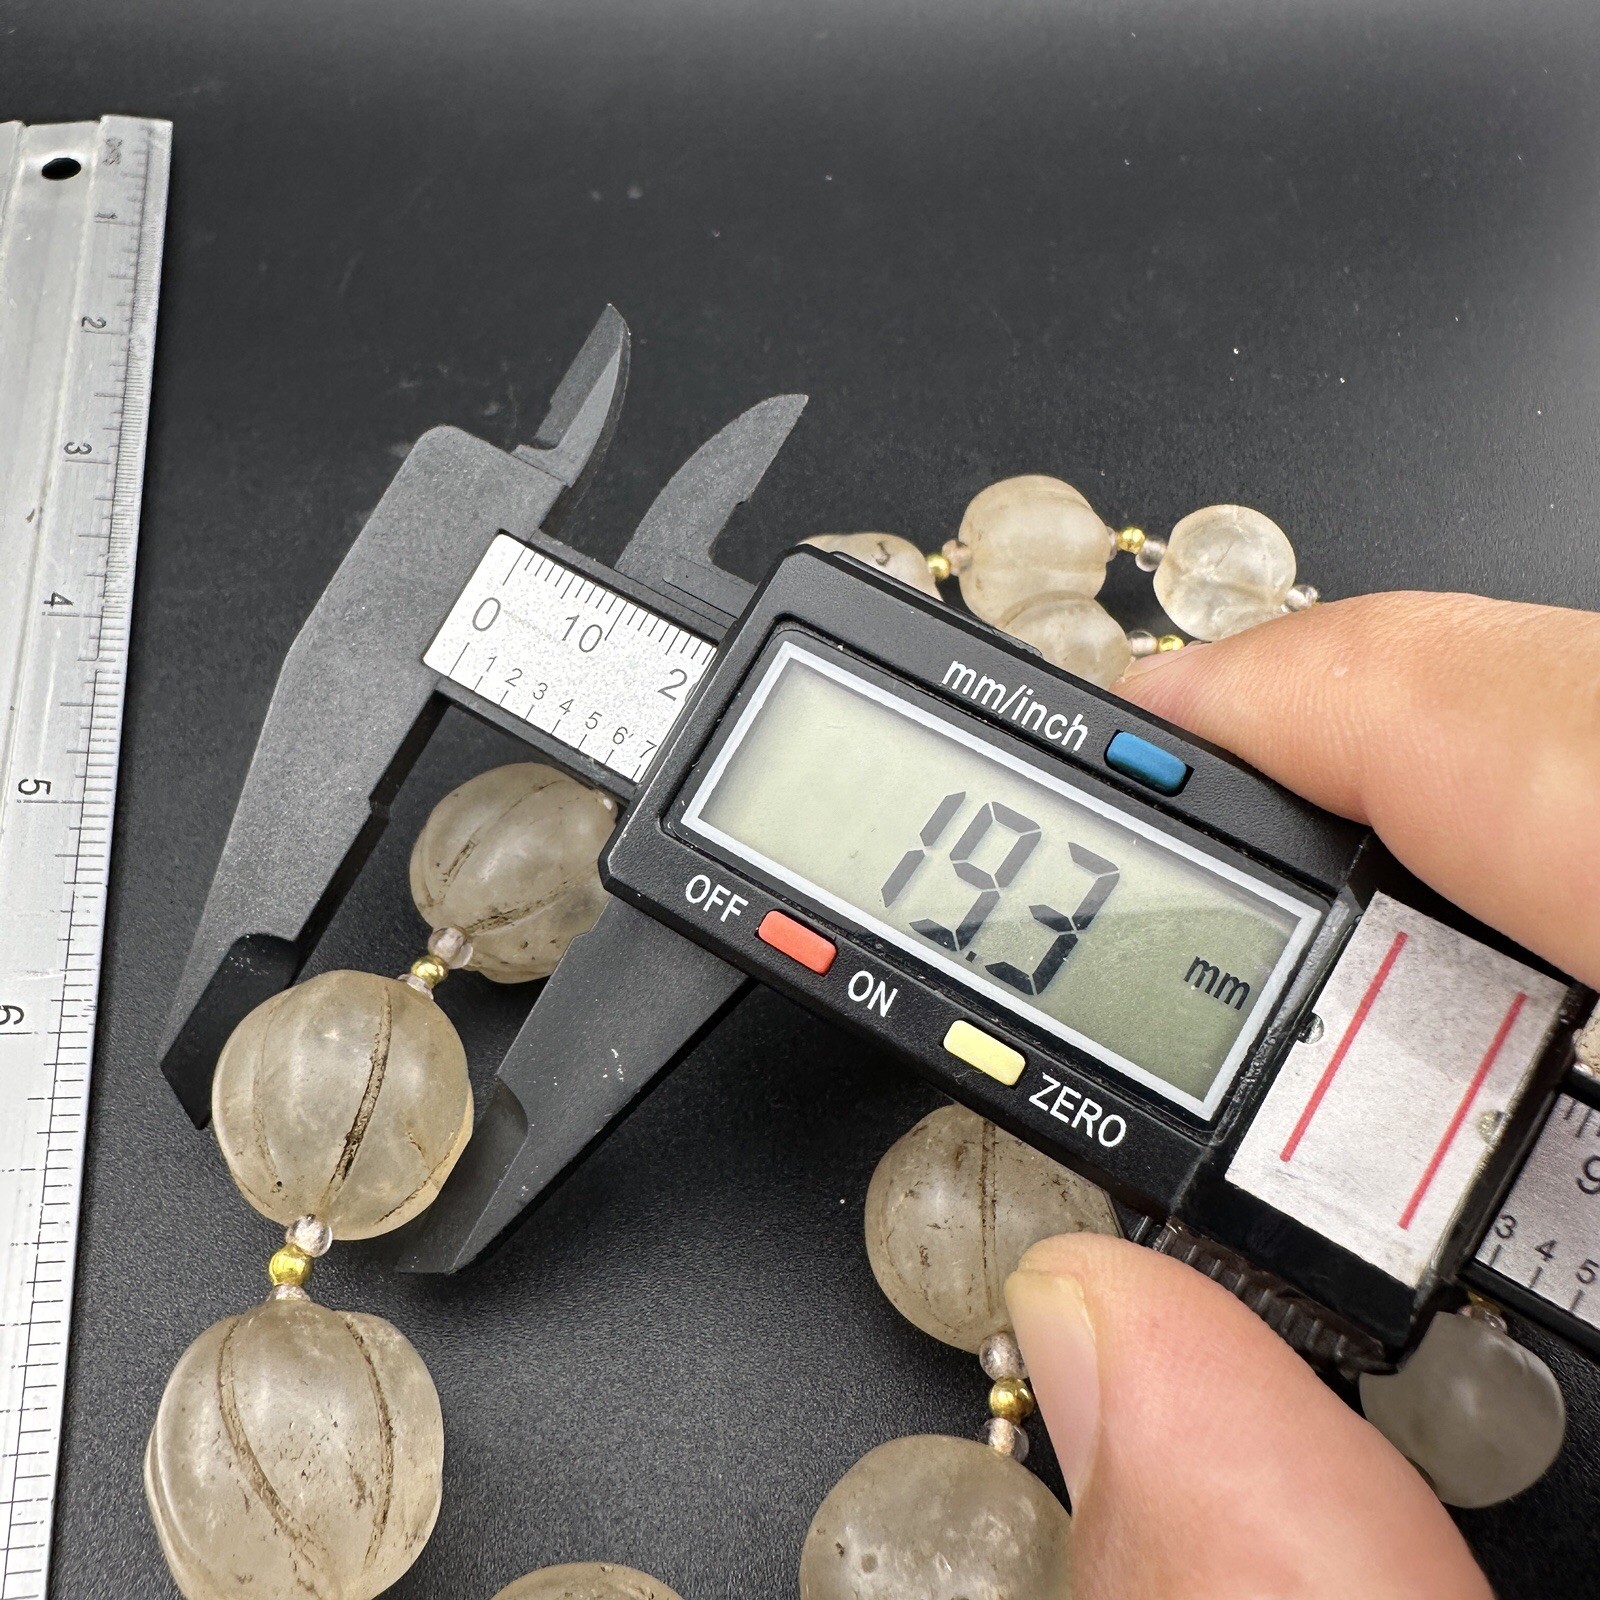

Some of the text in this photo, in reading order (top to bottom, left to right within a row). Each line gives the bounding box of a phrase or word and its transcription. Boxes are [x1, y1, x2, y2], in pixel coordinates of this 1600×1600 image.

[81, 316, 107, 328] 2
[64, 441, 92, 455] 3
[43, 591, 74, 609] 4
[472, 597, 501, 631] 0
[561, 614, 604, 653] 10
[485, 655, 657, 758] 1 2 3 4 5 6 7
[941, 659, 1090, 753] mm/inch
[18, 778, 51, 795] 5
[684, 873, 749, 924] OFF
[880, 791, 1251, 1011] 19.3 mm
[0, 1004, 24, 1025] 6
[847, 969, 898, 1018] ON
[1028, 1073, 1127, 1149] ZERO
[1494, 1214, 1600, 1285] 3 4 5
